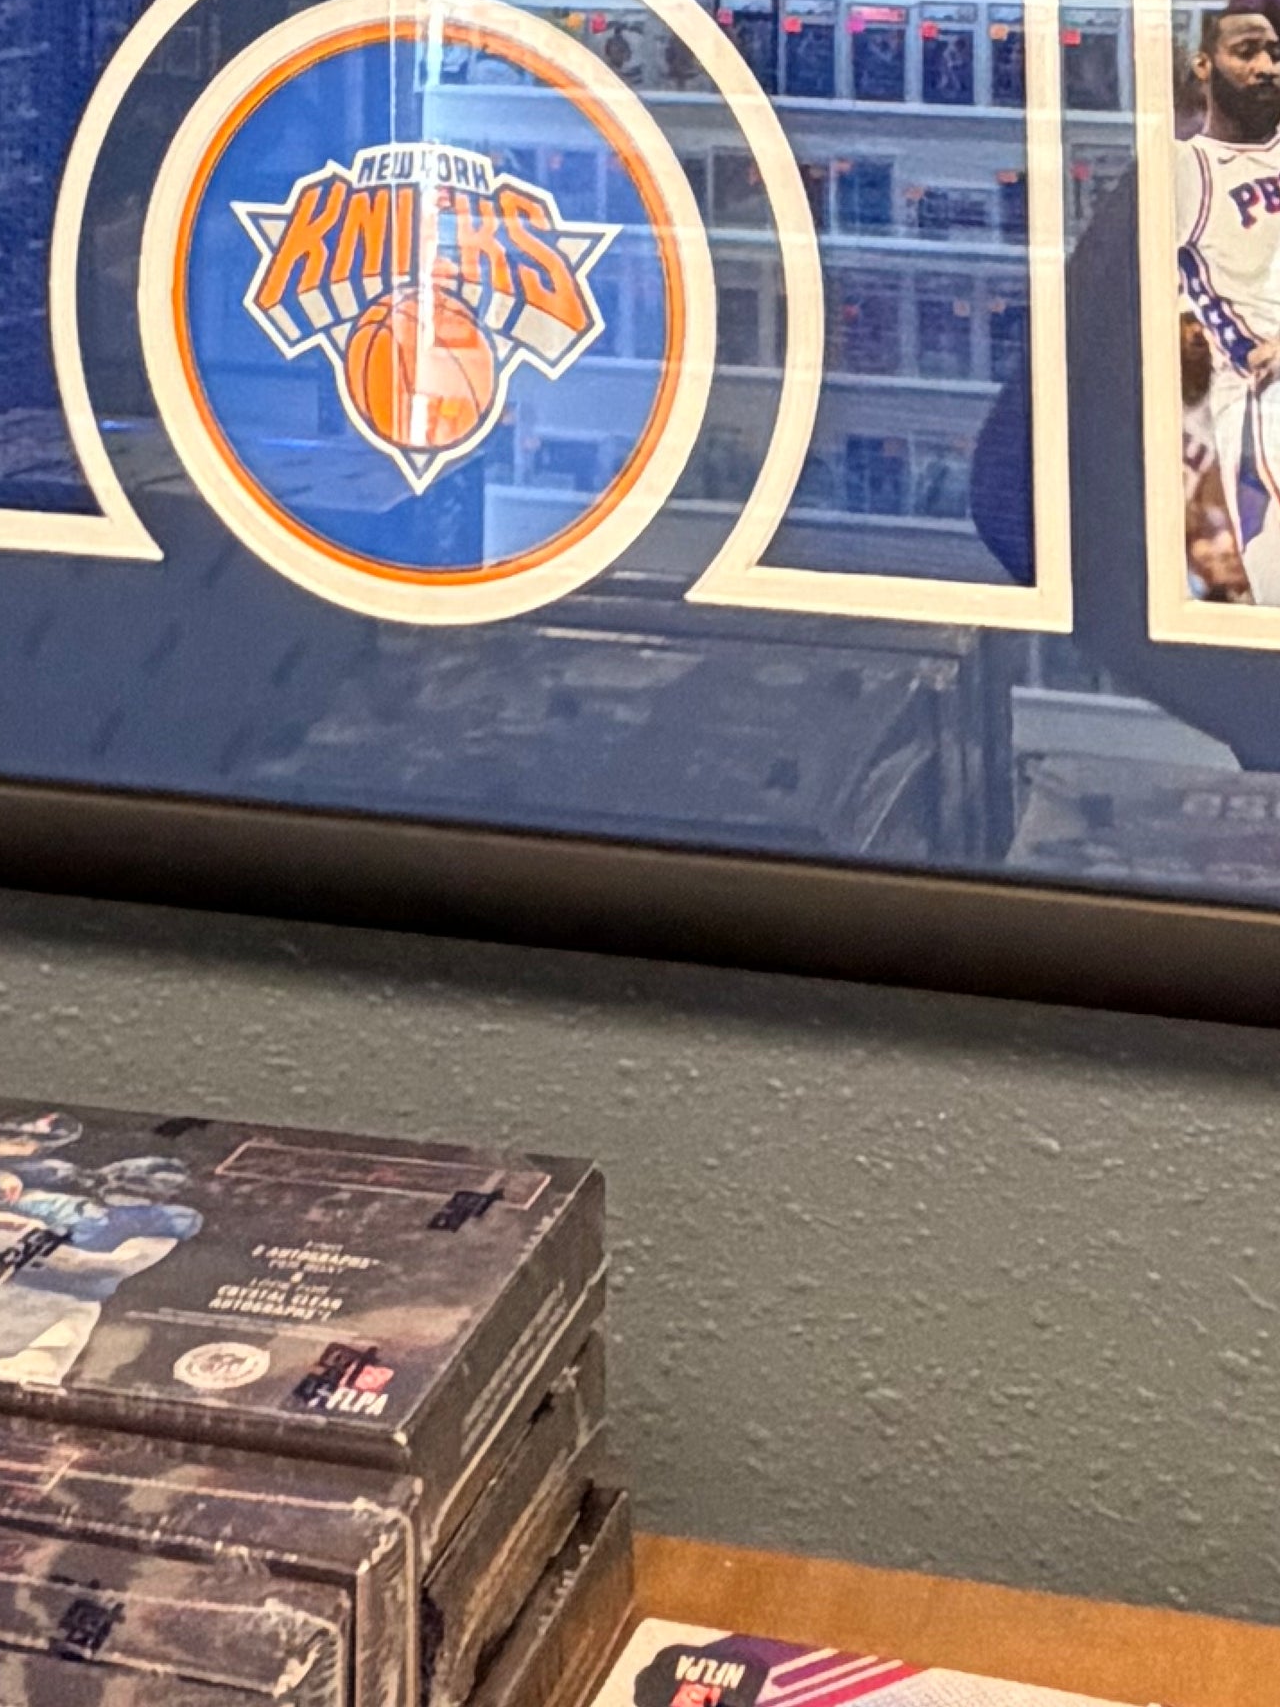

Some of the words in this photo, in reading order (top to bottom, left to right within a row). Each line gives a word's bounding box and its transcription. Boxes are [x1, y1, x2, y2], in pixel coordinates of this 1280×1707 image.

[356, 150, 415, 185] NEW
[417, 154, 490, 190] YORK
[673, 1654, 748, 1688] NFLPA
